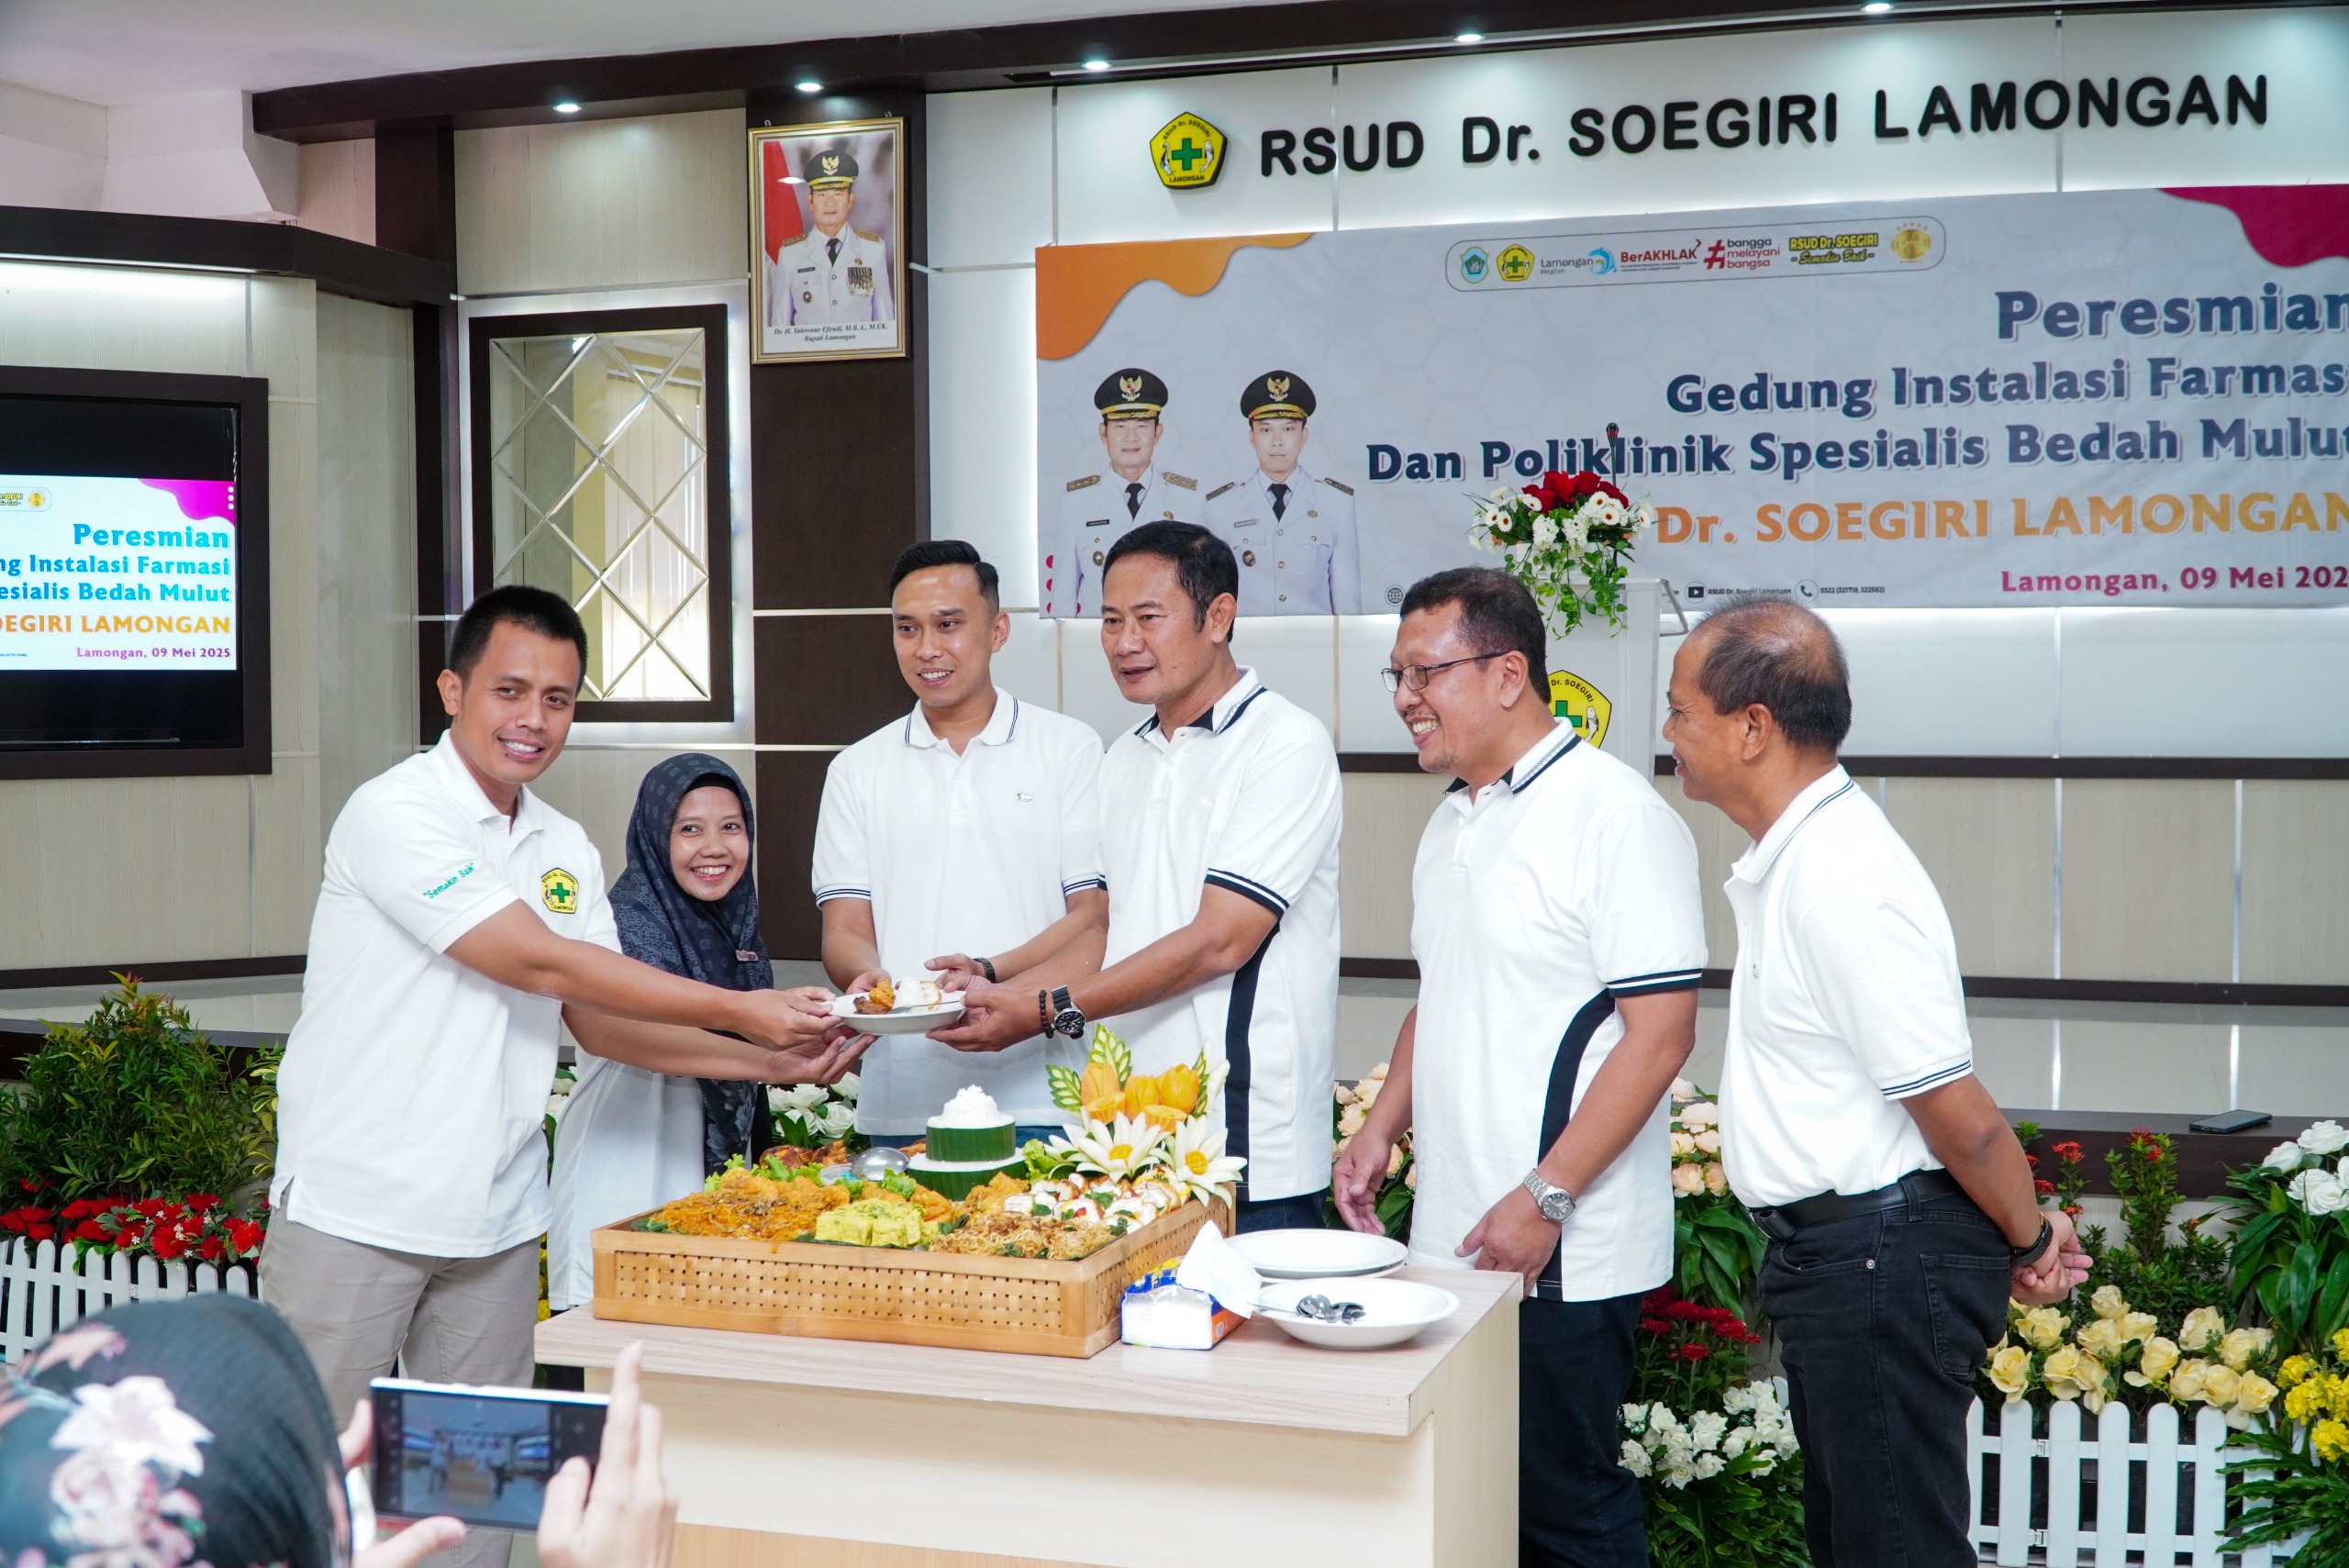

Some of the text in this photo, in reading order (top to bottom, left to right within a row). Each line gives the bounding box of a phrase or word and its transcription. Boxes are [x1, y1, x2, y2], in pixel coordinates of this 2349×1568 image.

[1163, 124, 1177, 140] RSUD
[1188, 119, 1211, 138] SOEGIRI
[1261, 74, 2267, 177] RSUD Dr. SOEGIRI LAMONGAN
[1169, 174, 1205, 183] LAMONGAN
[1727, 238, 1772, 249] bangga
[1789, 233, 1879, 250] RSUD Dr. SOEGIRI
[1620, 244, 1698, 262] BerAKHLAK
[1727, 247, 1780, 258] melayani
[1541, 258, 1594, 268] Lamongan
[1727, 259, 1770, 270] bangsa
[1995, 282, 2349, 339] Peresmian
[1666, 356, 2349, 418] Gedung Instalasi Farmas
[1366, 444, 1463, 480] Dan
[1480, 433, 1731, 477] Poliklinik
[1750, 426, 1986, 481] Spesialis
[2005, 420, 2178, 463] Bedah
[1654, 492, 2349, 543] Dr. SOEGIRI LAMONGAN
[72, 523, 228, 549] Peresmian
[29, 554, 129, 573] Instalasi
[138, 556, 229, 575] Farmasi
[2001, 569, 2168, 596] Lamongan,
[2180, 567, 2217, 590] 09
[2230, 566, 2285, 589] Mei
[78, 583, 150, 601] Bedah
[160, 584, 230, 602] Mulut
[0, 614, 229, 633] EGIRI LAMONGAN
[77, 647, 230, 660] Lamongan, 09 Mei 2025
[1564, 679, 1594, 703] SOEGIRI
